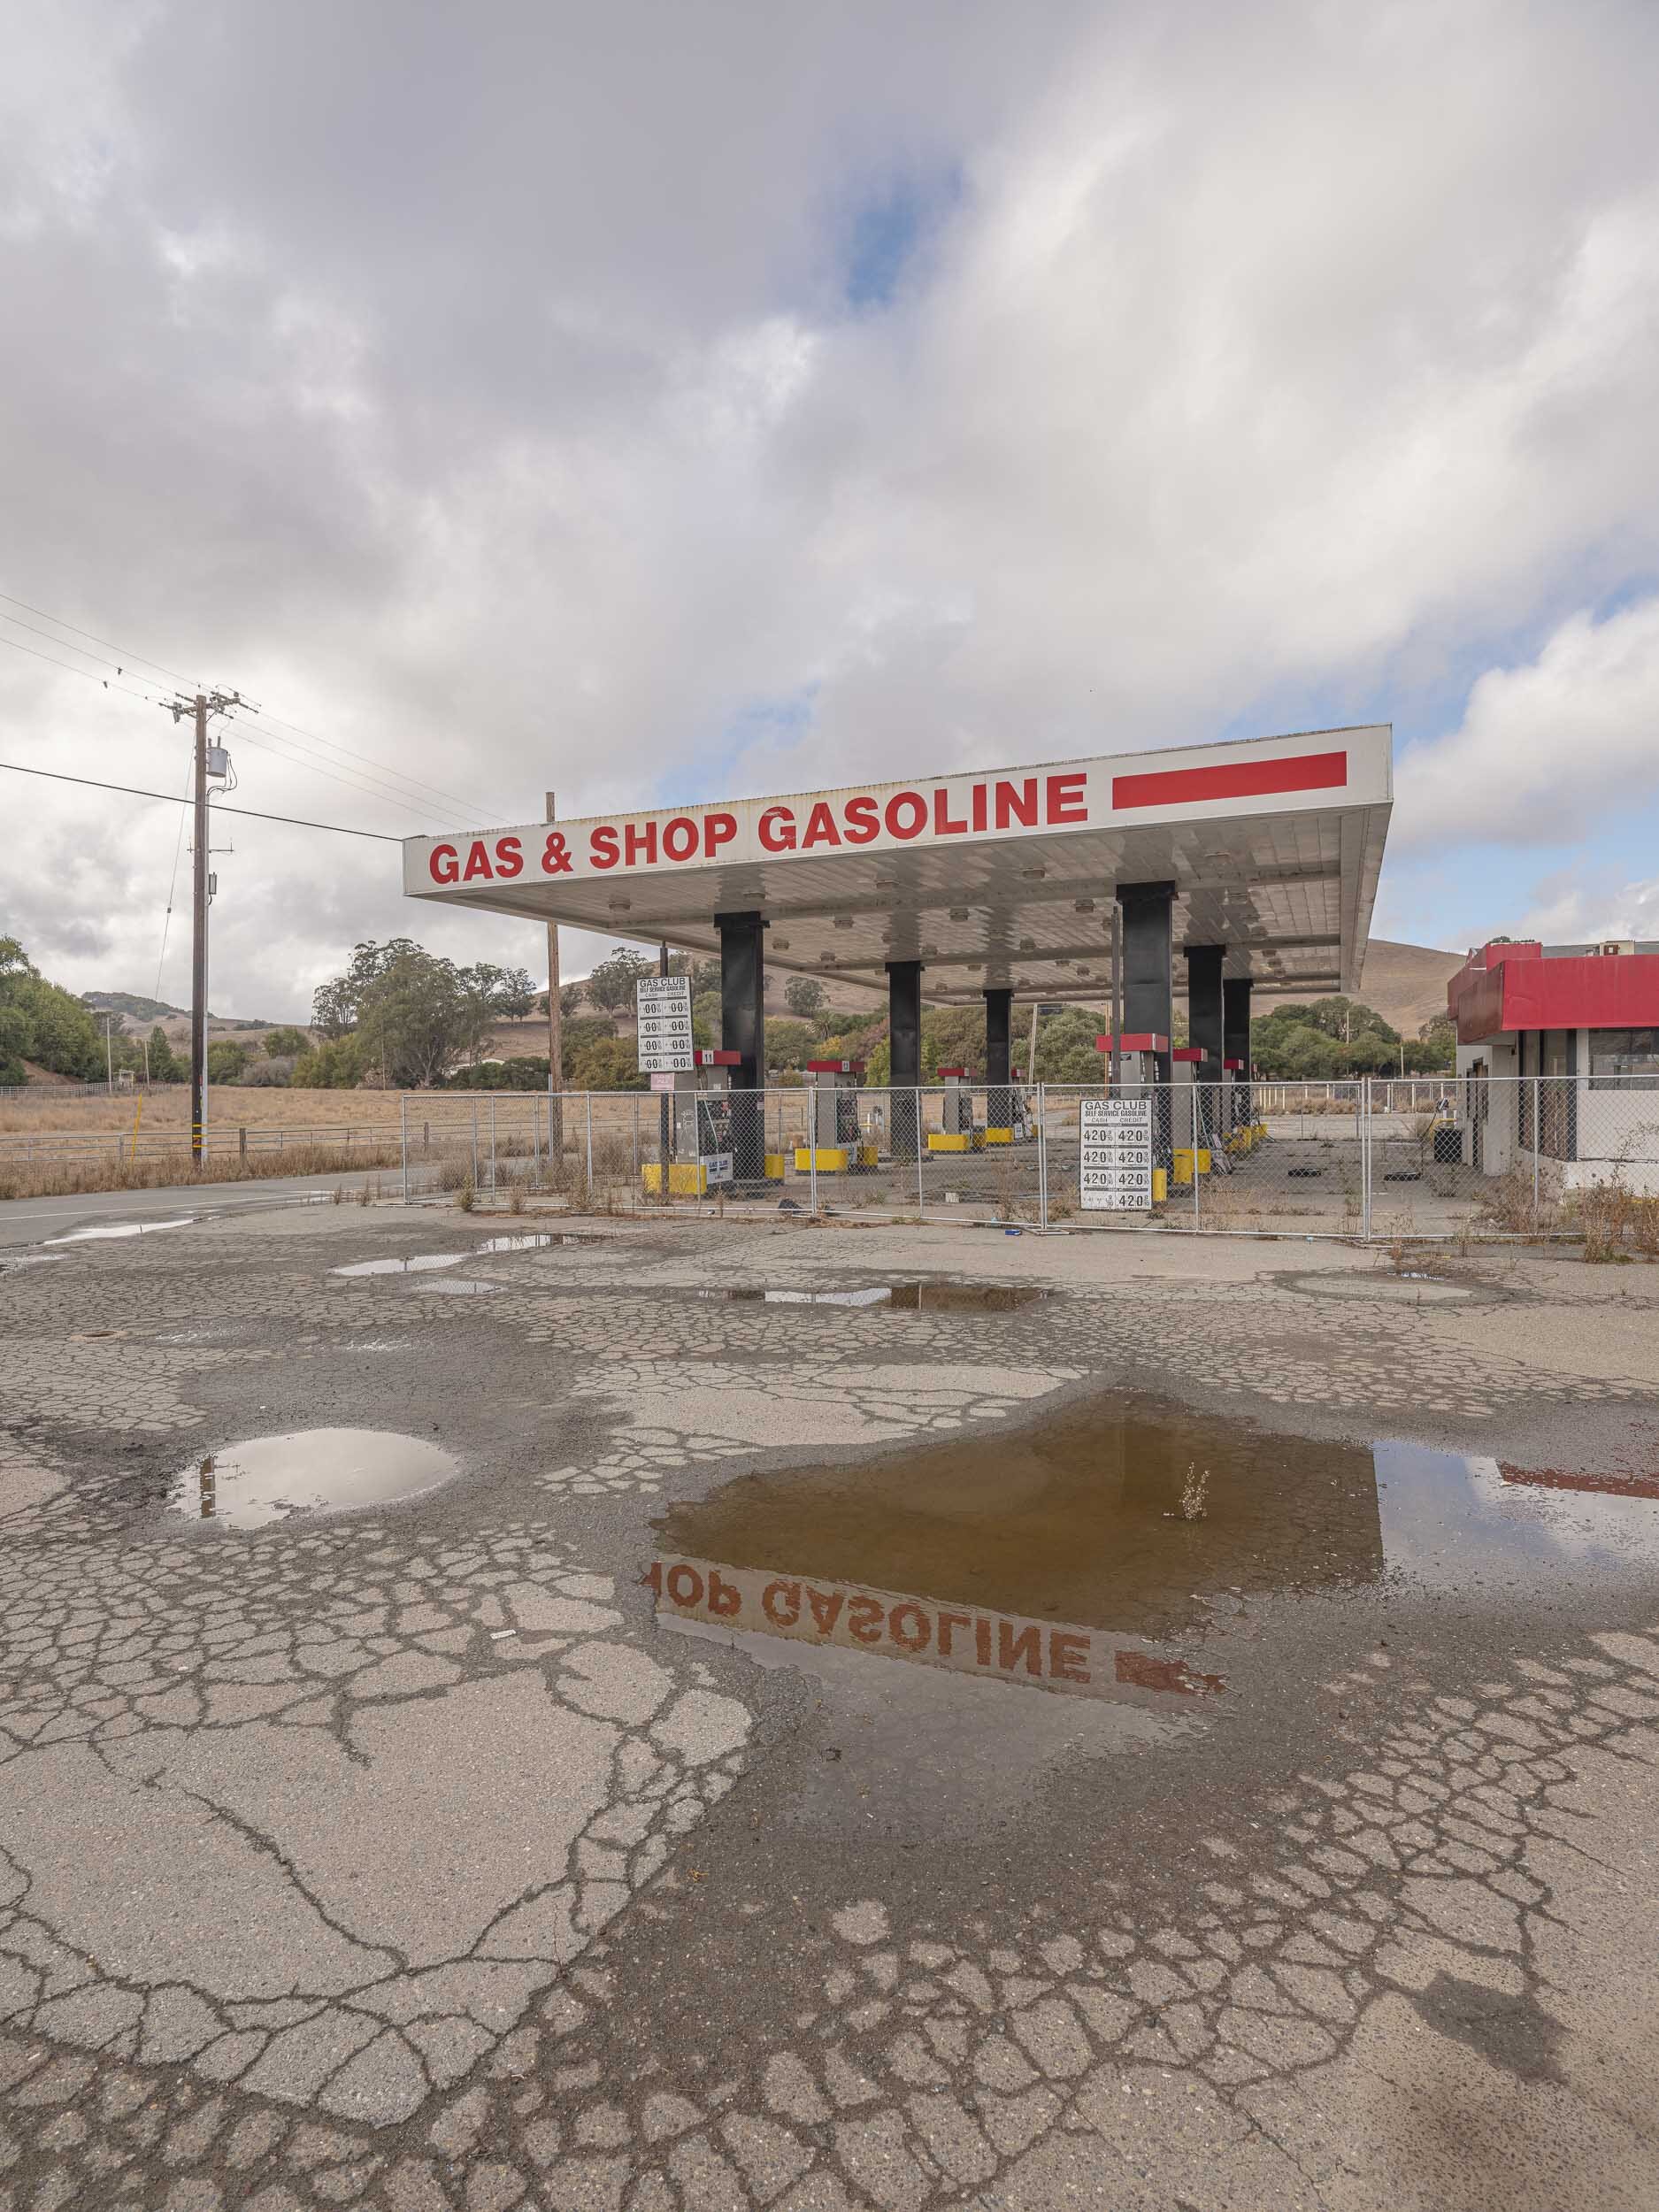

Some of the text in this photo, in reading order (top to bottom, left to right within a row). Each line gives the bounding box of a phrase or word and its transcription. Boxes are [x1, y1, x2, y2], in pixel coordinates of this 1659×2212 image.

[429, 772, 1088, 884] GAS & SHOP GASOLINE
[640, 979, 658, 987] GAS
[1085, 1101, 1147, 1110] GAS CLUB
[1084, 1130, 1106, 1141] 420
[1118, 1130, 1142, 1141] 420
[1084, 1151, 1106, 1163] 420
[1118, 1152, 1143, 1163] 420
[1084, 1173, 1106, 1185] 420
[1118, 1174, 1143, 1185] 420
[1119, 1195, 1143, 1206] 420
